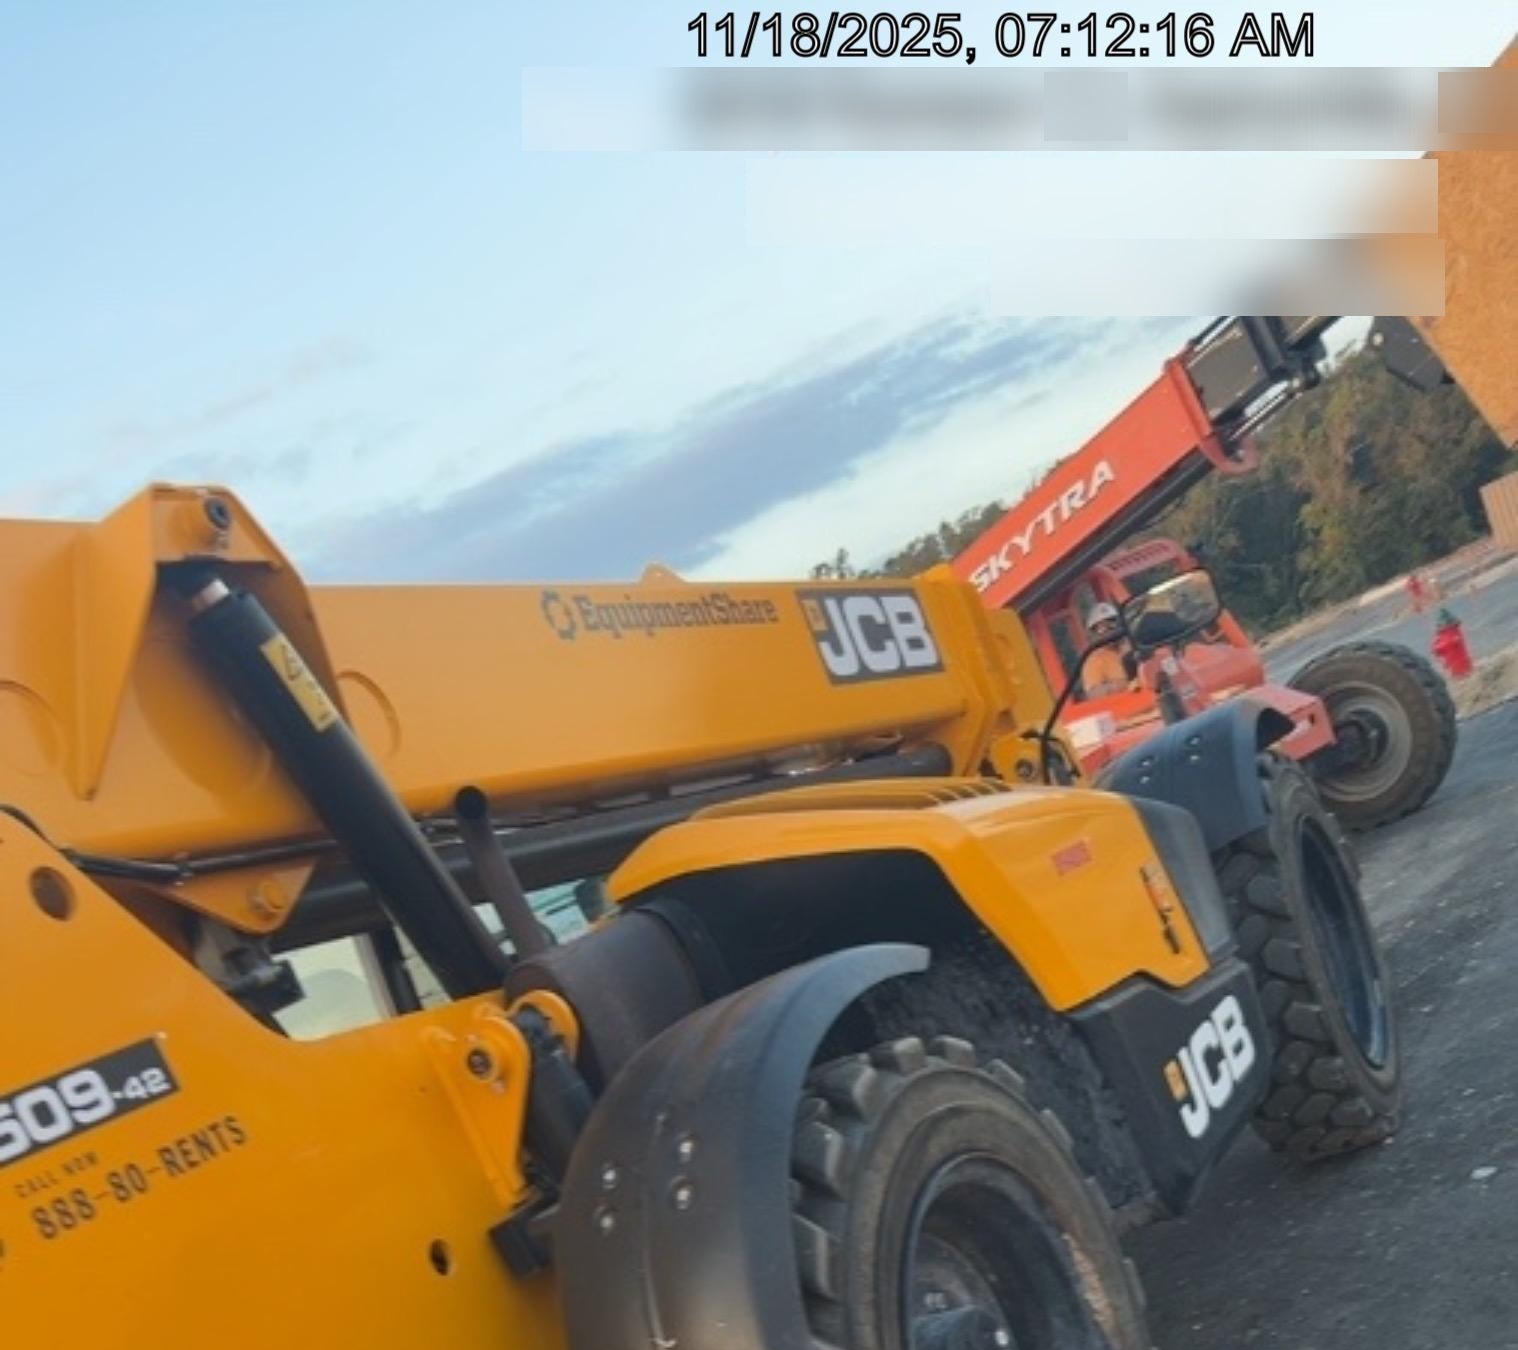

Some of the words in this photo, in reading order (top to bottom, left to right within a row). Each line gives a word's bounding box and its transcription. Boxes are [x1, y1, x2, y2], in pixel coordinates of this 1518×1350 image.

[968, 460, 1115, 593] SKYTRA
[573, 592, 780, 639] EquipmentShare
[819, 594, 939, 677] JCB
[1177, 995, 1256, 1138] JCB
[31, 1114, 247, 1240] 888-80-RENTS
